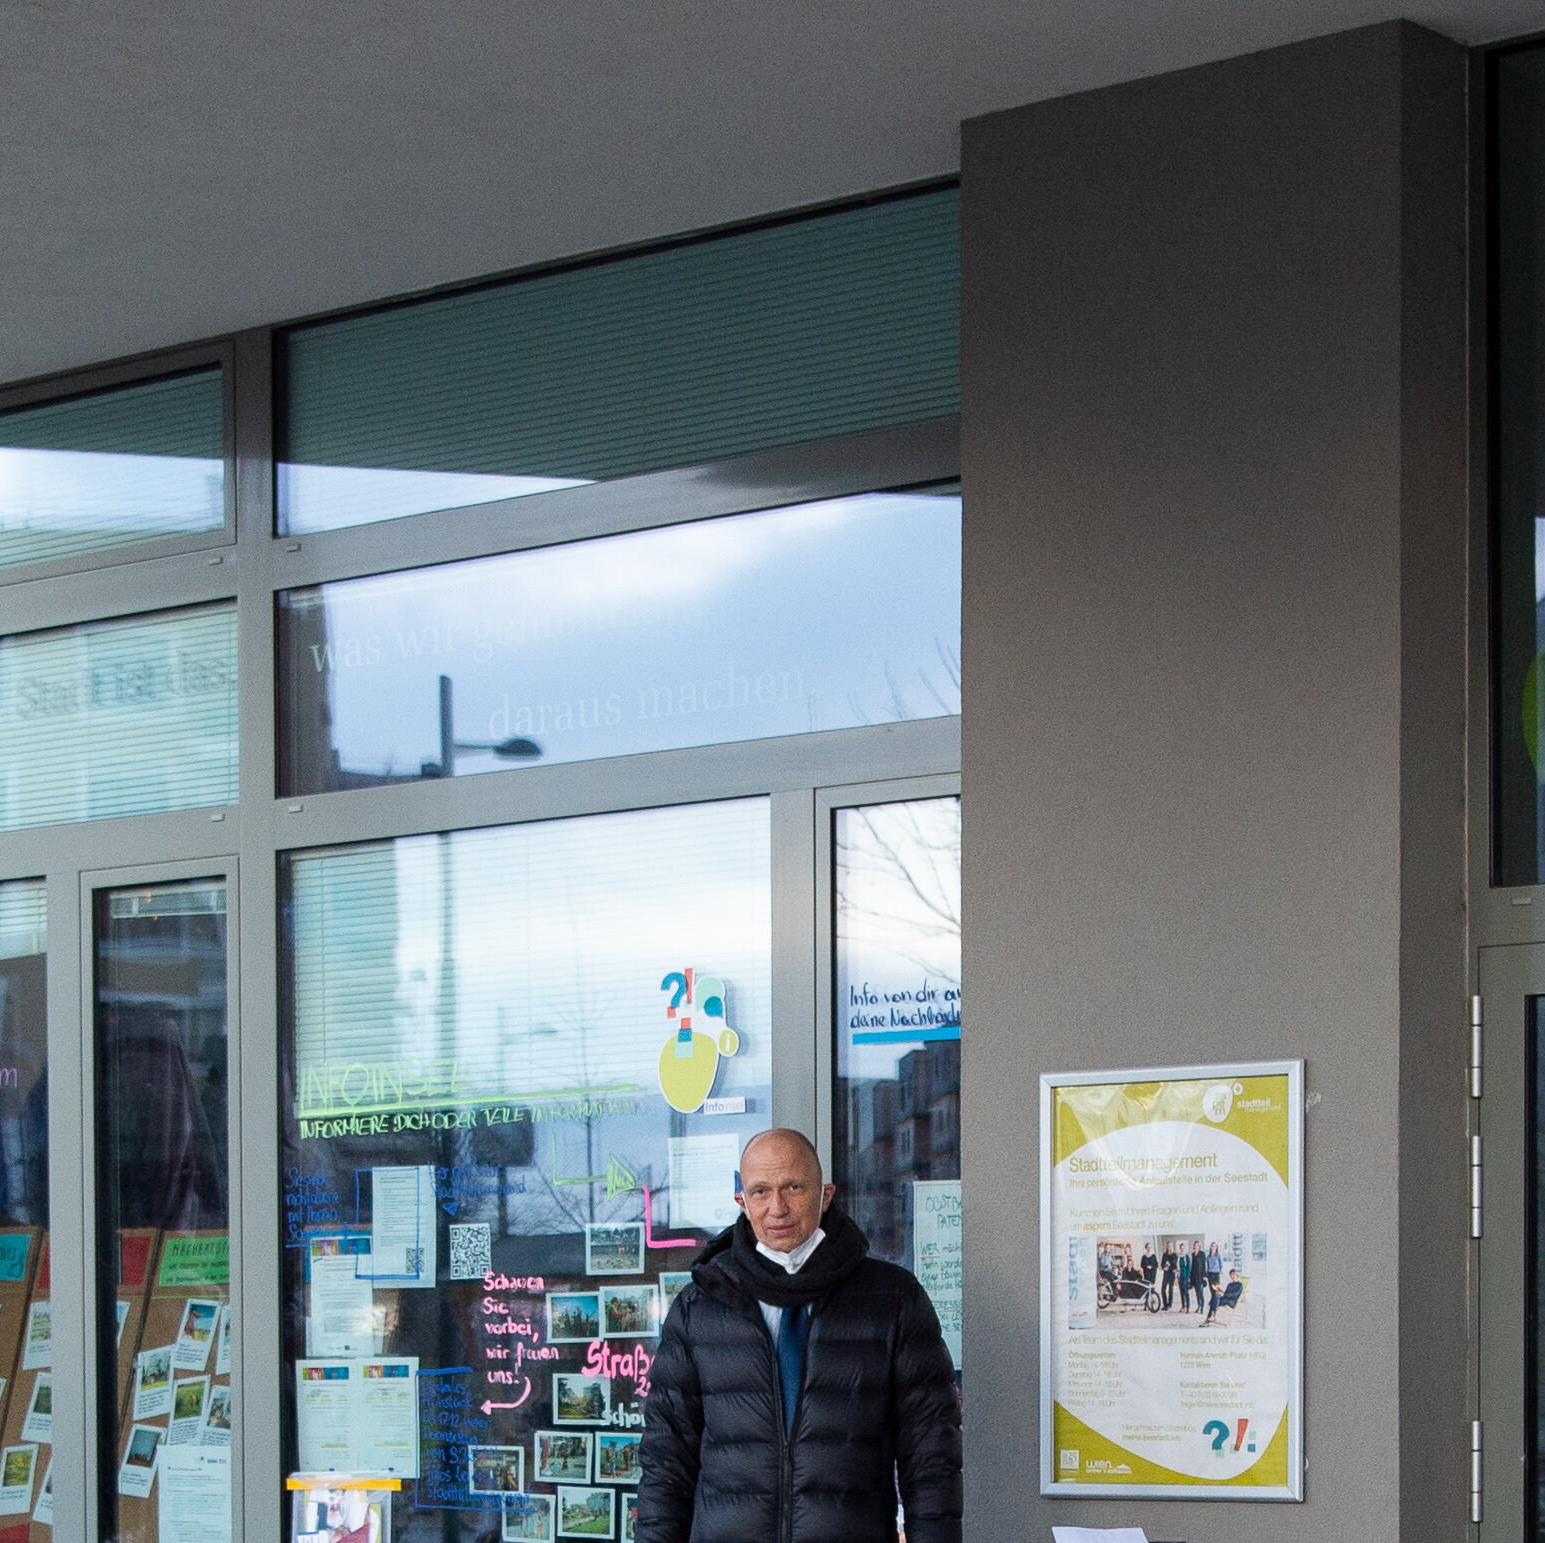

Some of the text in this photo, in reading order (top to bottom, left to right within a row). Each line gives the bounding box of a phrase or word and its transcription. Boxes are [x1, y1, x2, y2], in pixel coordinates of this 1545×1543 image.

[310, 635, 380, 674] was
[399, 622, 455, 660] wir
[488, 663, 804, 741] daraus machen
[850, 982, 878, 1007] Info
[884, 989, 912, 1003] von
[850, 1008, 885, 1029] deine
[300, 1058, 469, 1114] INFOINSEL
[300, 1115, 390, 1139] INFORMIERE
[432, 1109, 478, 1130] ODER
[1069, 1153, 1218, 1174] Stadtteilmanagement
[1194, 1174, 1203, 1184] in
[1205, 1173, 1222, 1184] der
[1224, 1172, 1268, 1183] Seestadt
[483, 1271, 544, 1291] Schauen
[483, 1297, 509, 1315] Sie
[485, 1317, 539, 1343] vorbei,
[486, 1346, 510, 1360] wir
[581, 1340, 655, 1384] Straß
